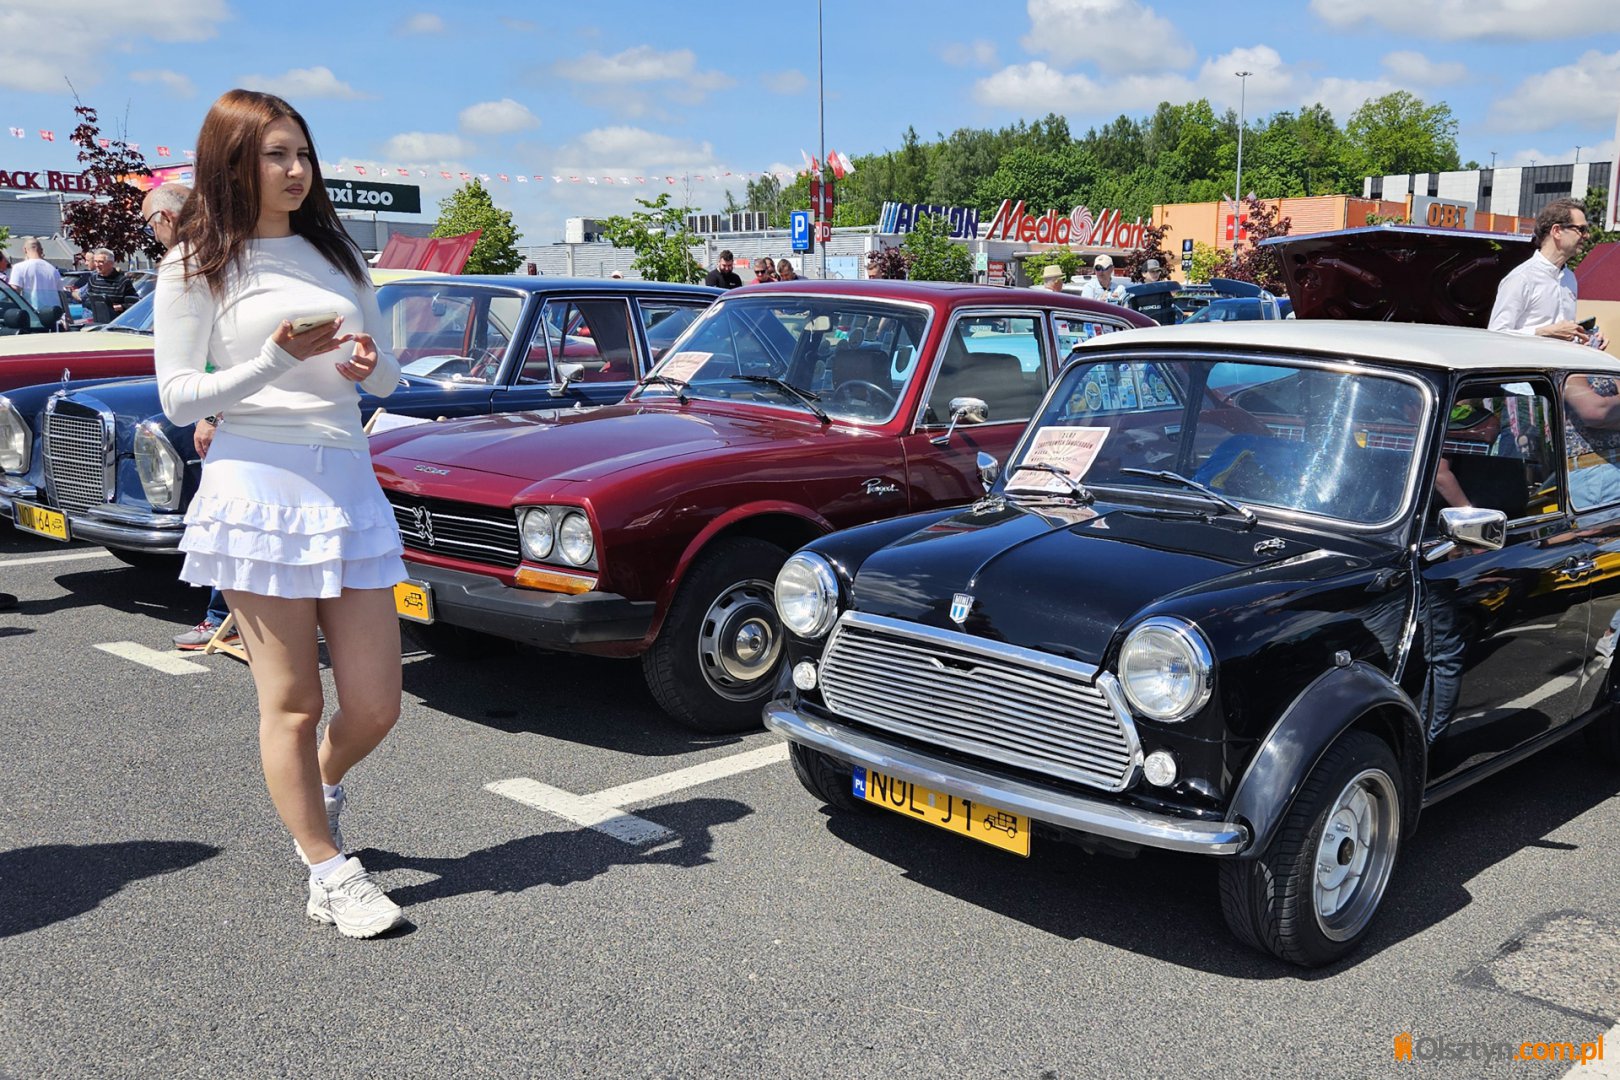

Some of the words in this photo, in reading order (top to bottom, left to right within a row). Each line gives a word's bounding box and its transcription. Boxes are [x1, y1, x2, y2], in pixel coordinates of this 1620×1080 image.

[356, 189, 394, 206] zoo
[794, 215, 805, 239] P
[986, 198, 1072, 244] Media
[1427, 202, 1468, 230] OBI
[855, 779, 865, 791] PL
